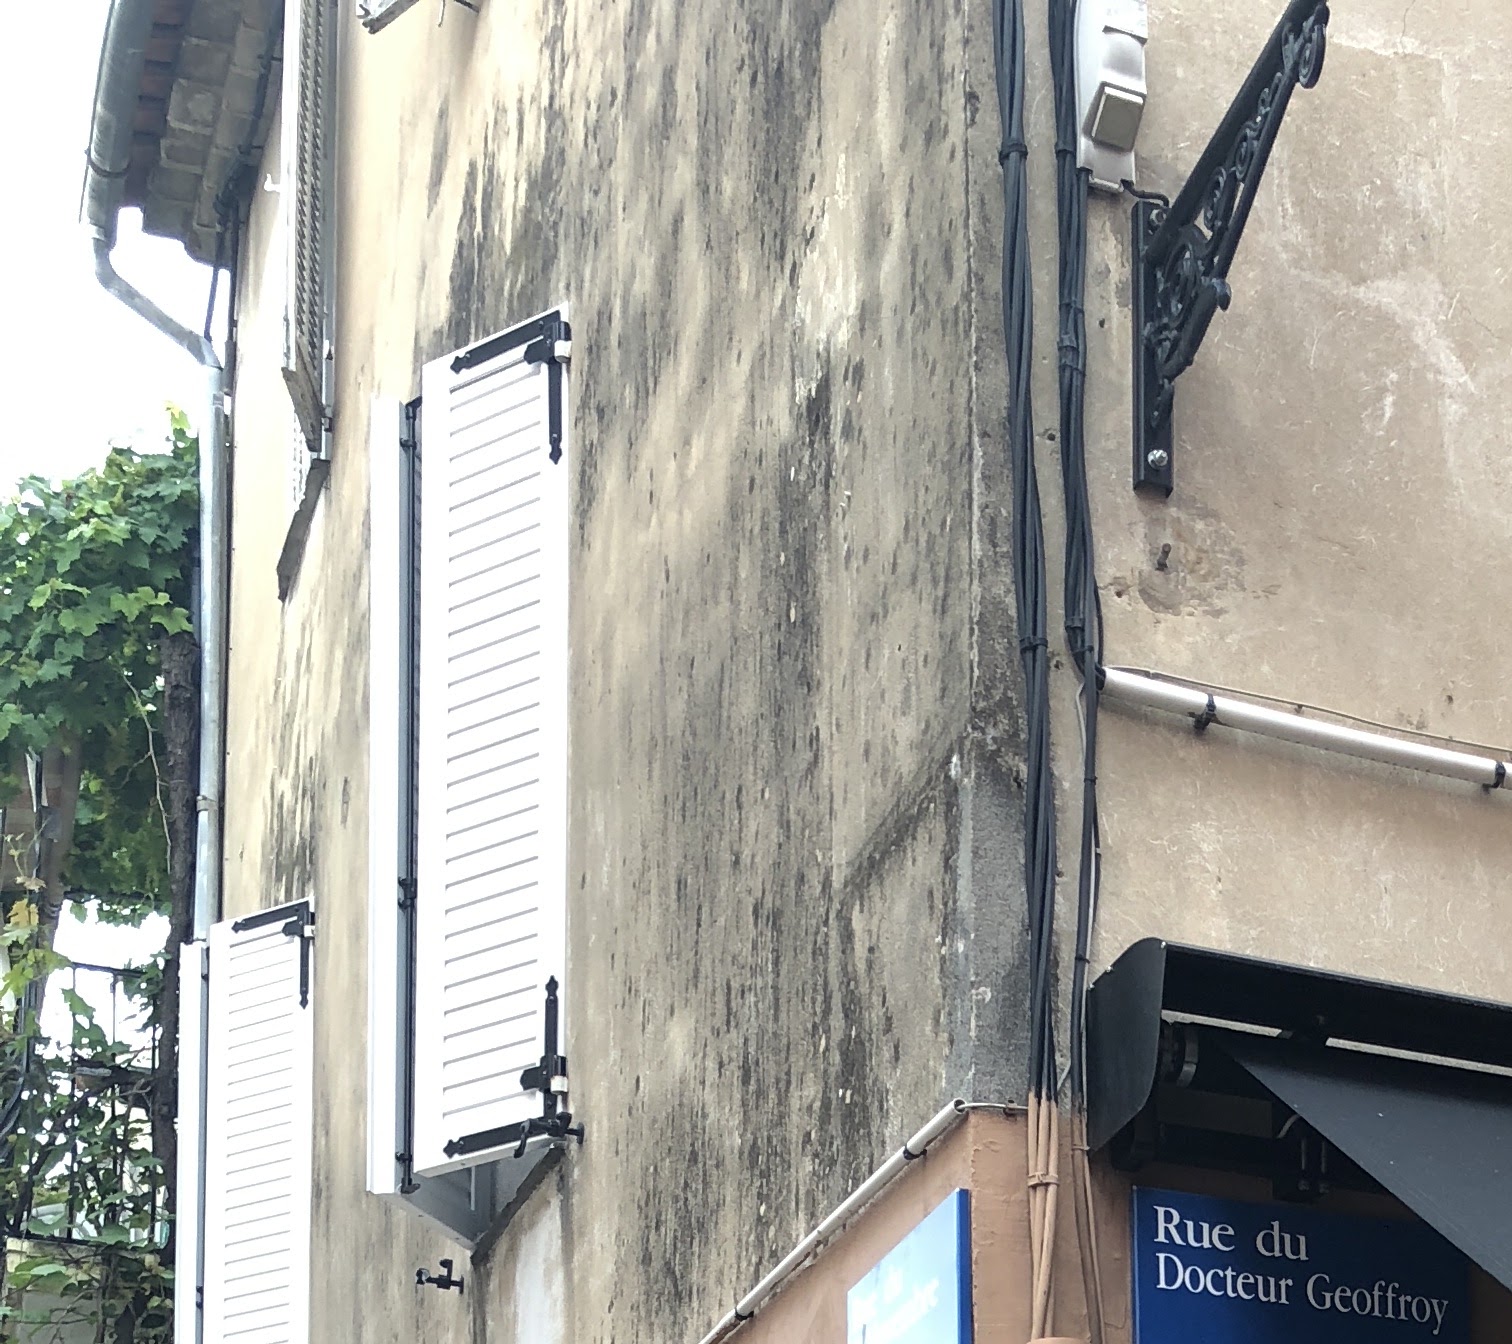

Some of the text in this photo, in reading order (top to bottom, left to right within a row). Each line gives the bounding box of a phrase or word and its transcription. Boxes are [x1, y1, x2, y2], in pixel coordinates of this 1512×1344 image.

[1152, 1204, 1309, 1261] Rue du
[1155, 1252, 1449, 1336] Docteur Geoffroy
